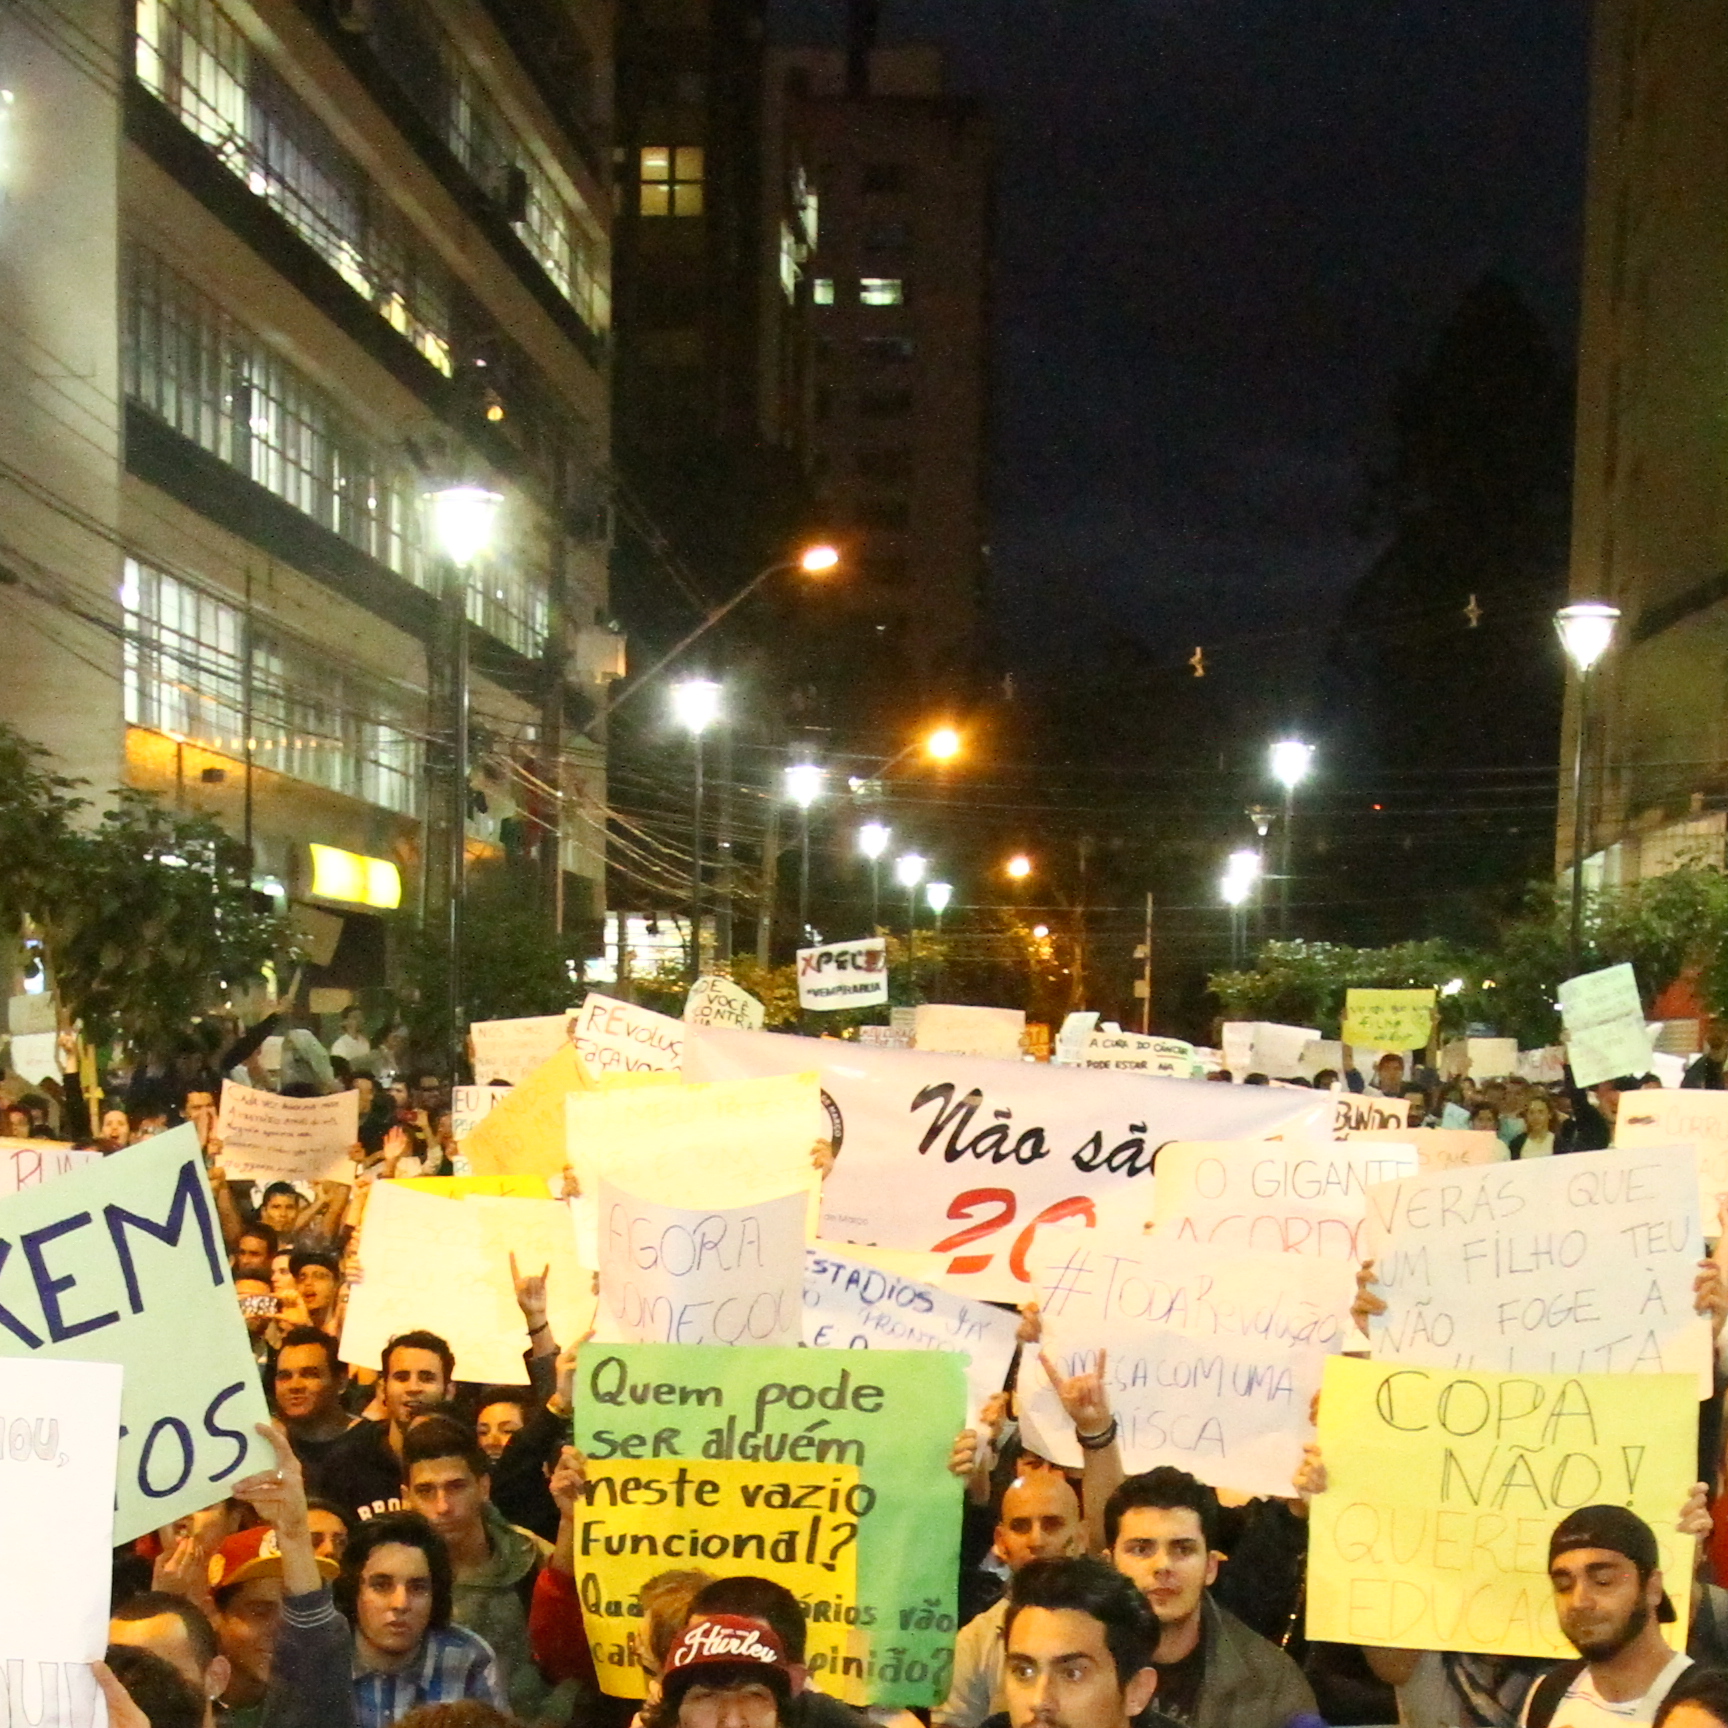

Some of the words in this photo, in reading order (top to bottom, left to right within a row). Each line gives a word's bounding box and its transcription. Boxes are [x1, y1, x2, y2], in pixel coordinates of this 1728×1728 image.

[584, 1004, 684, 1058] REVOLUÇ
[909, 1081, 1050, 1165] Não
[1194, 1157, 1228, 1200] O
[1371, 1173, 1526, 1234] VERÁS
[1567, 1163, 1663, 1208] QUE
[609, 1203, 763, 1277] AGORA
[1378, 1245, 1432, 1288] UM
[1621, 1214, 1690, 1259] TEU
[1378, 1298, 1456, 1354] NÃO
[1496, 1288, 1601, 1336] FOGE
[590, 1356, 722, 1409] Quem
[755, 1368, 886, 1436] pode
[1375, 1369, 1599, 1447] COPA
[702, 1414, 866, 1468] alguém
[581, 1466, 721, 1509] neste
[740, 1478, 877, 1519] vazio
[1439, 1443, 1647, 1511] NÃO!
[580, 1516, 858, 1574] Funcional?
[673, 1621, 779, 1667] Hurley
[898, 1597, 957, 1635] vão
[806, 1646, 955, 1699] pinião?
